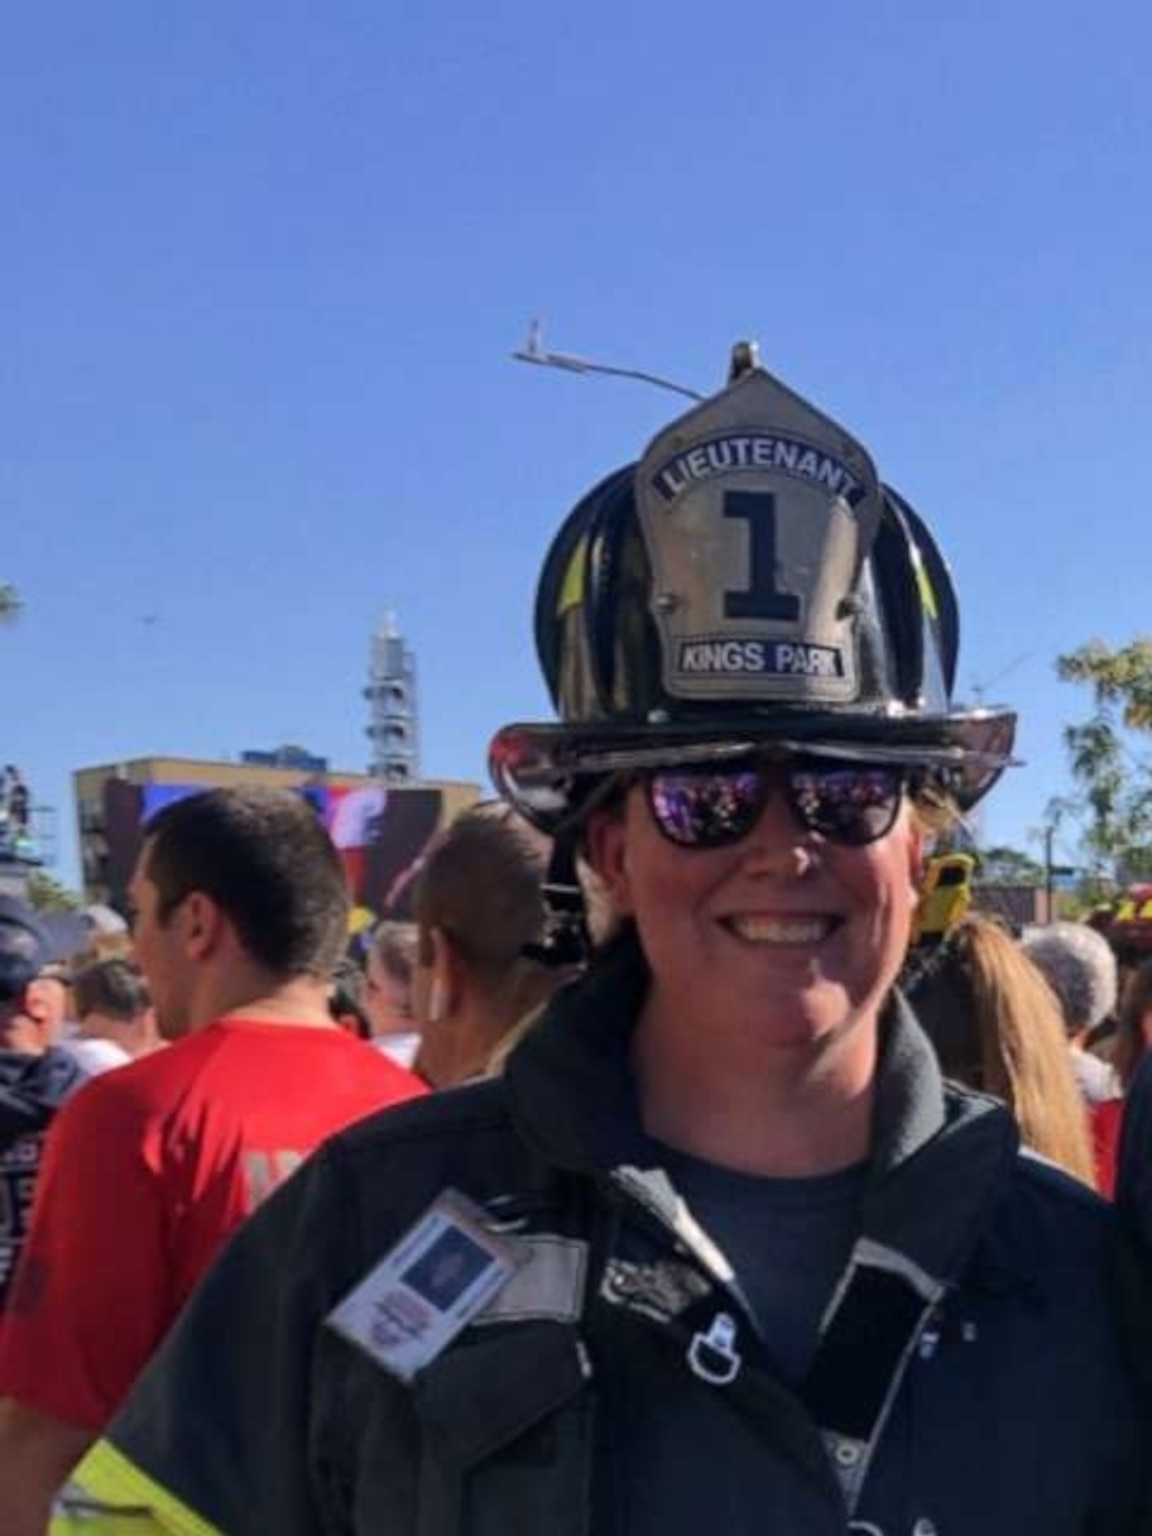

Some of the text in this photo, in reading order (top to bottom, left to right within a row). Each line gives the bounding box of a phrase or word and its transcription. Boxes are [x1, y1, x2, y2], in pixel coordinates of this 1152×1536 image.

[662, 437, 859, 496] LIEUTENANT
[721, 490, 800, 621] 1
[681, 641, 838, 676] KINGS PARK
